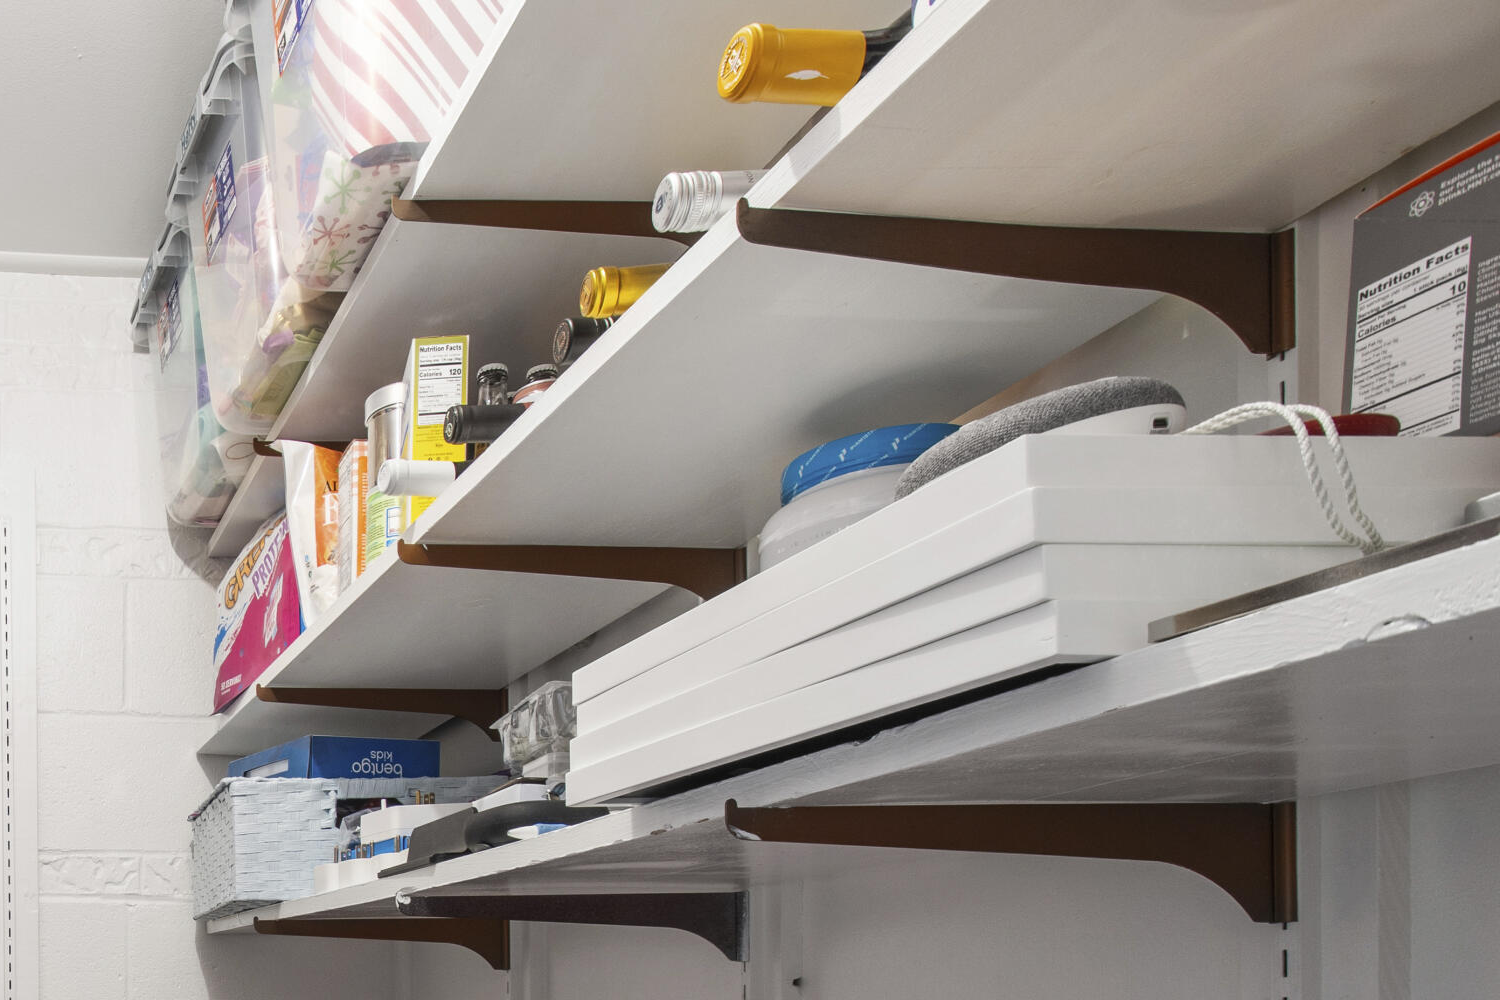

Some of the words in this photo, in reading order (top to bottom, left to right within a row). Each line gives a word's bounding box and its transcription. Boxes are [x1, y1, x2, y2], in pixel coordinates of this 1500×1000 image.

[1359, 266, 1421, 301] Nutrition
[1425, 243, 1469, 269] Facts
[1357, 316, 1397, 338] Calories
[1450, 281, 1466, 296] 10
[449, 368, 462, 376] 120
[370, 750, 393, 762] kids
[352, 758, 403, 778] bentgo
